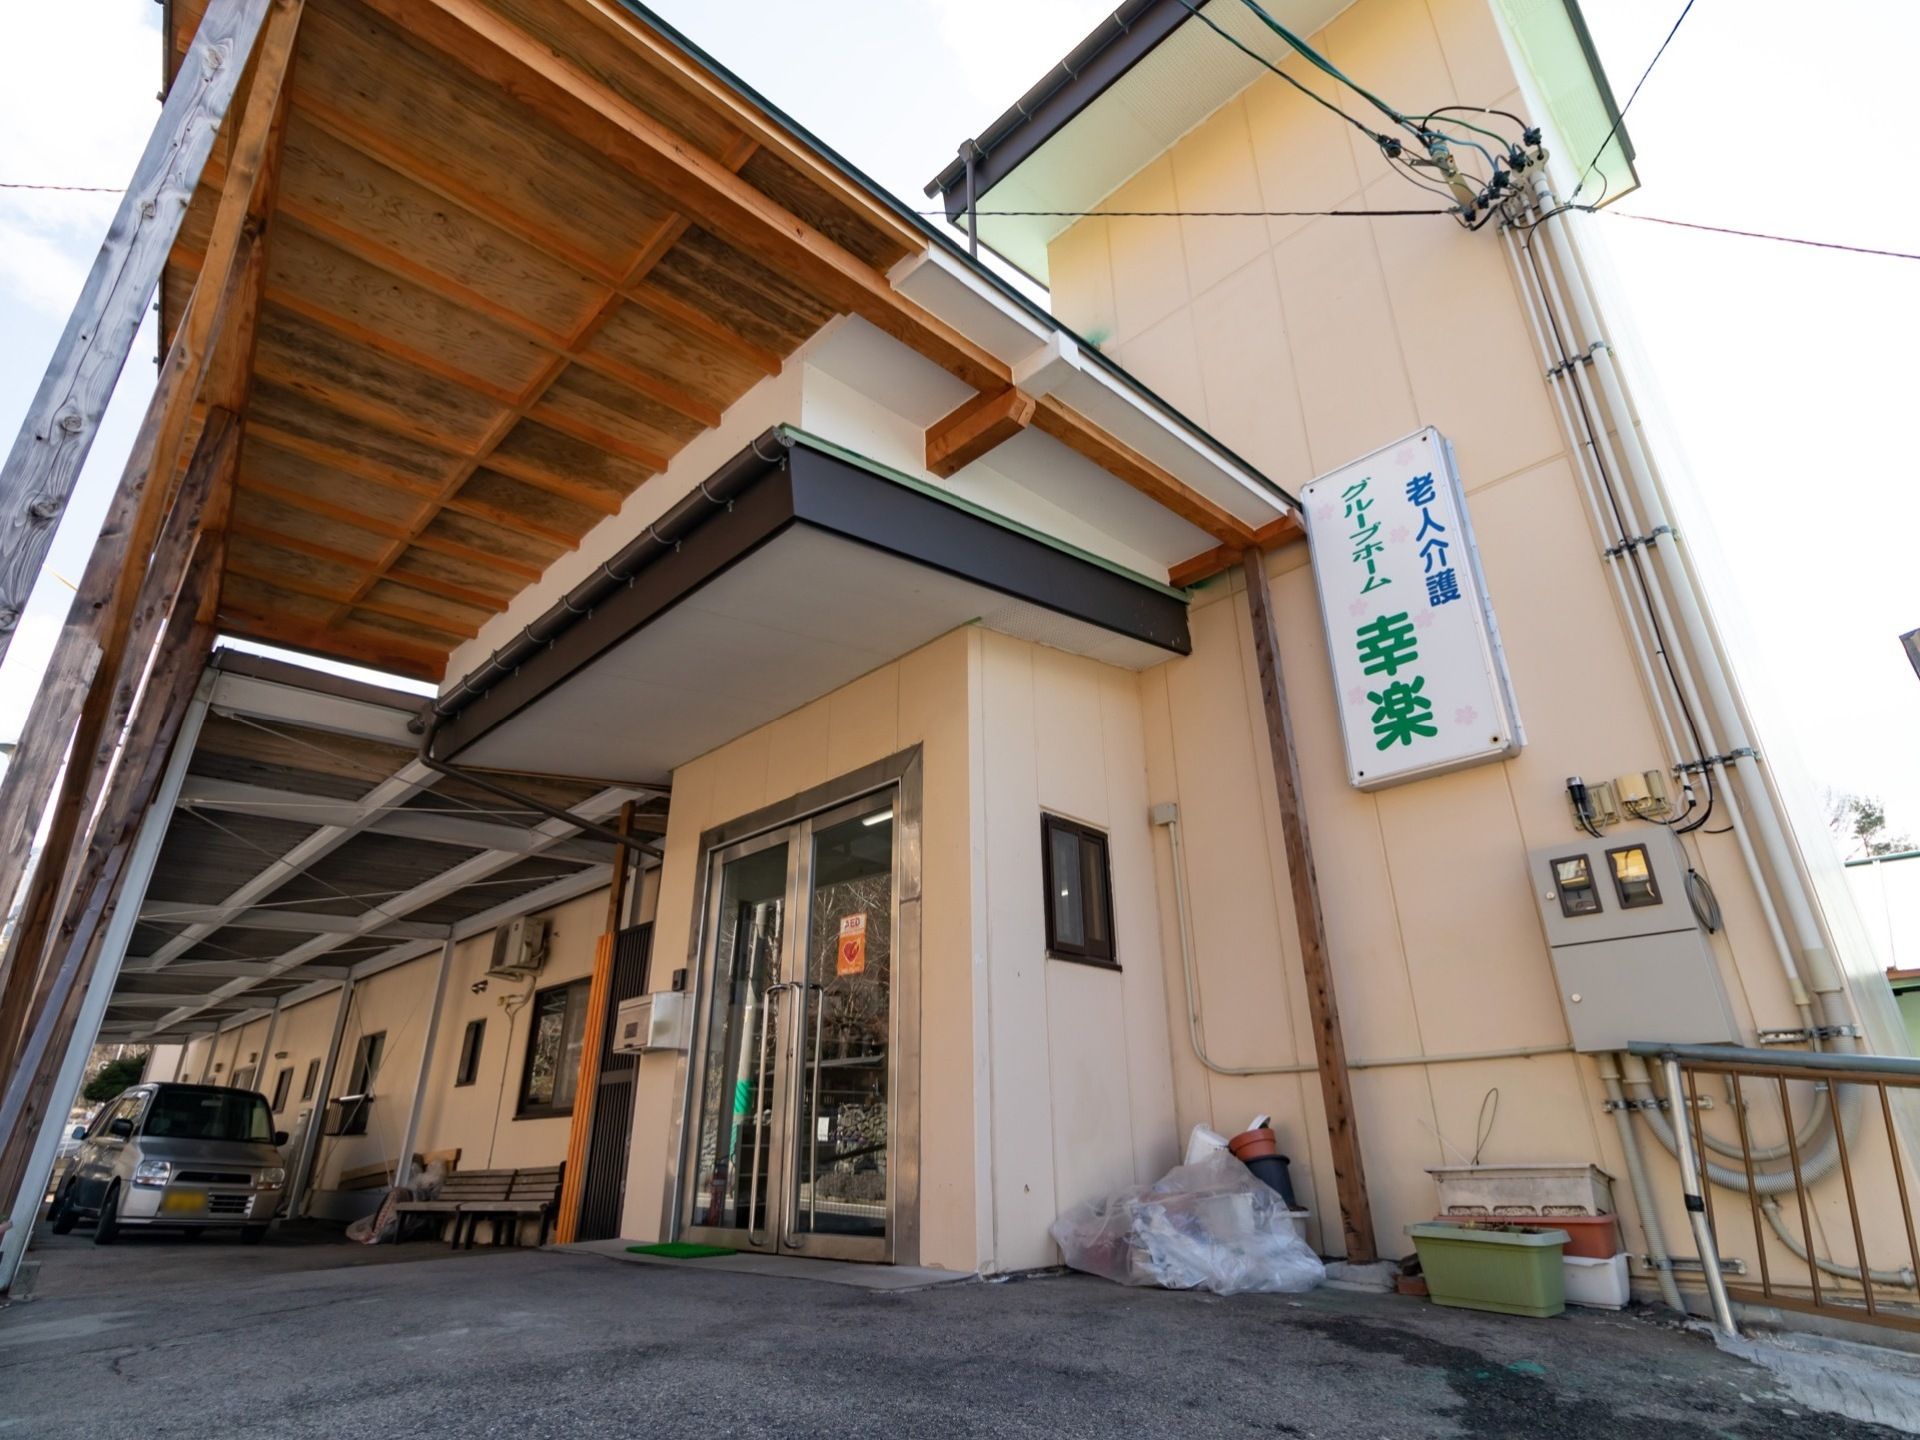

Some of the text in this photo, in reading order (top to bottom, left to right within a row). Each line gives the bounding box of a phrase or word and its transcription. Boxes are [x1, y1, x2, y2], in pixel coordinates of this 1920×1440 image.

[1406, 472, 1462, 607] 老人介護
[1356, 611, 1438, 751] 幸楽
[844, 917, 861, 929] AED
